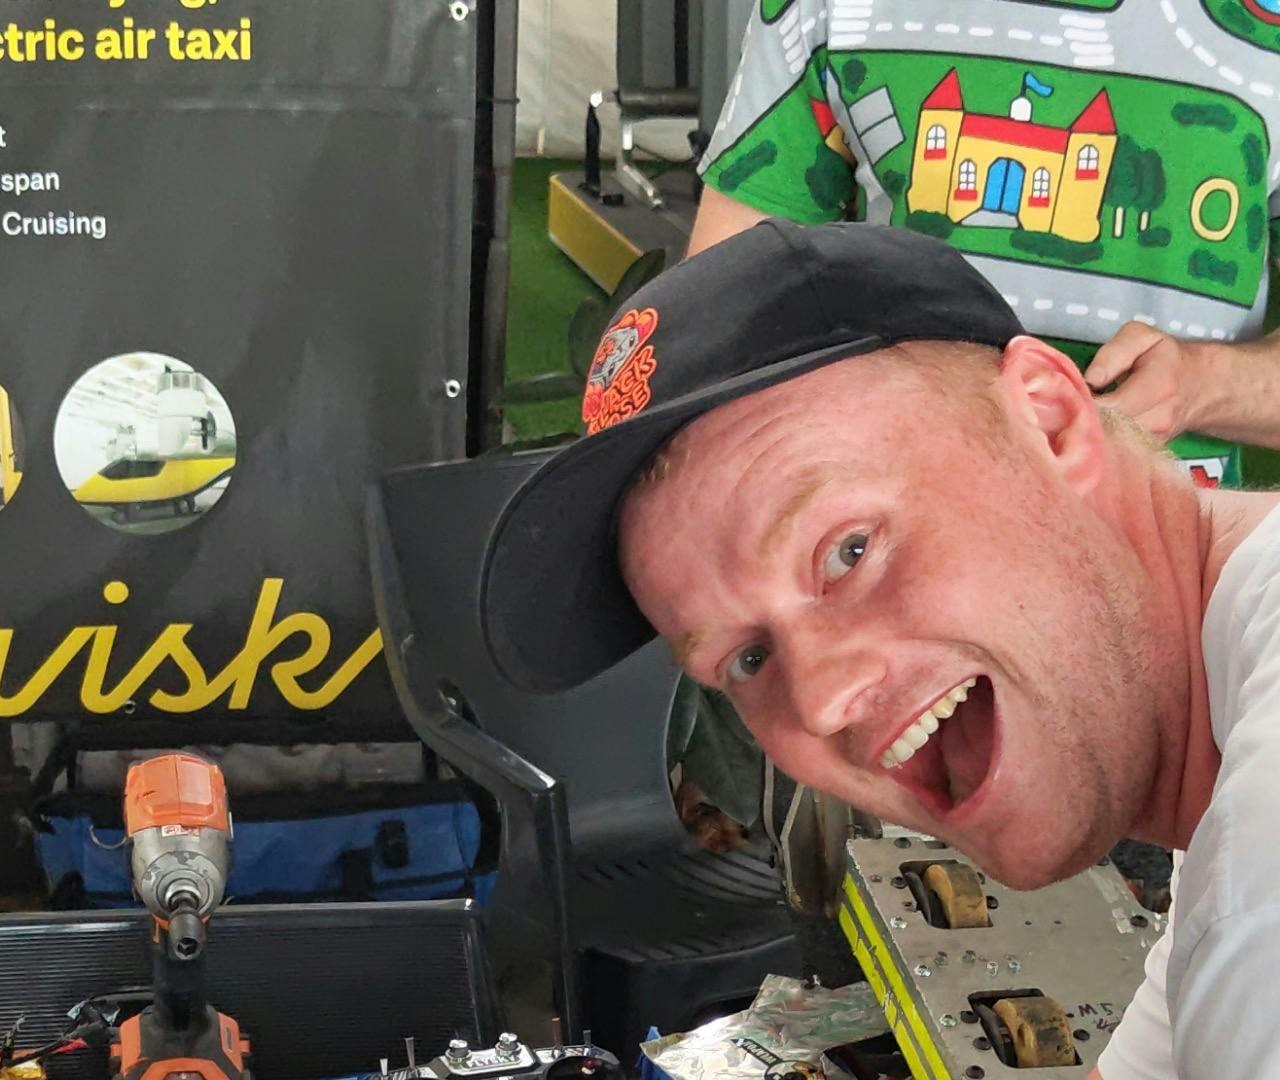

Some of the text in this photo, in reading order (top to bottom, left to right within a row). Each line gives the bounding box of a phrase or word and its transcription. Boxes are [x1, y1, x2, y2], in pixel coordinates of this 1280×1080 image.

[95, 18, 156, 61] air
[165, 18, 252, 61] taxi
[2, 210, 107, 240] Cruising
